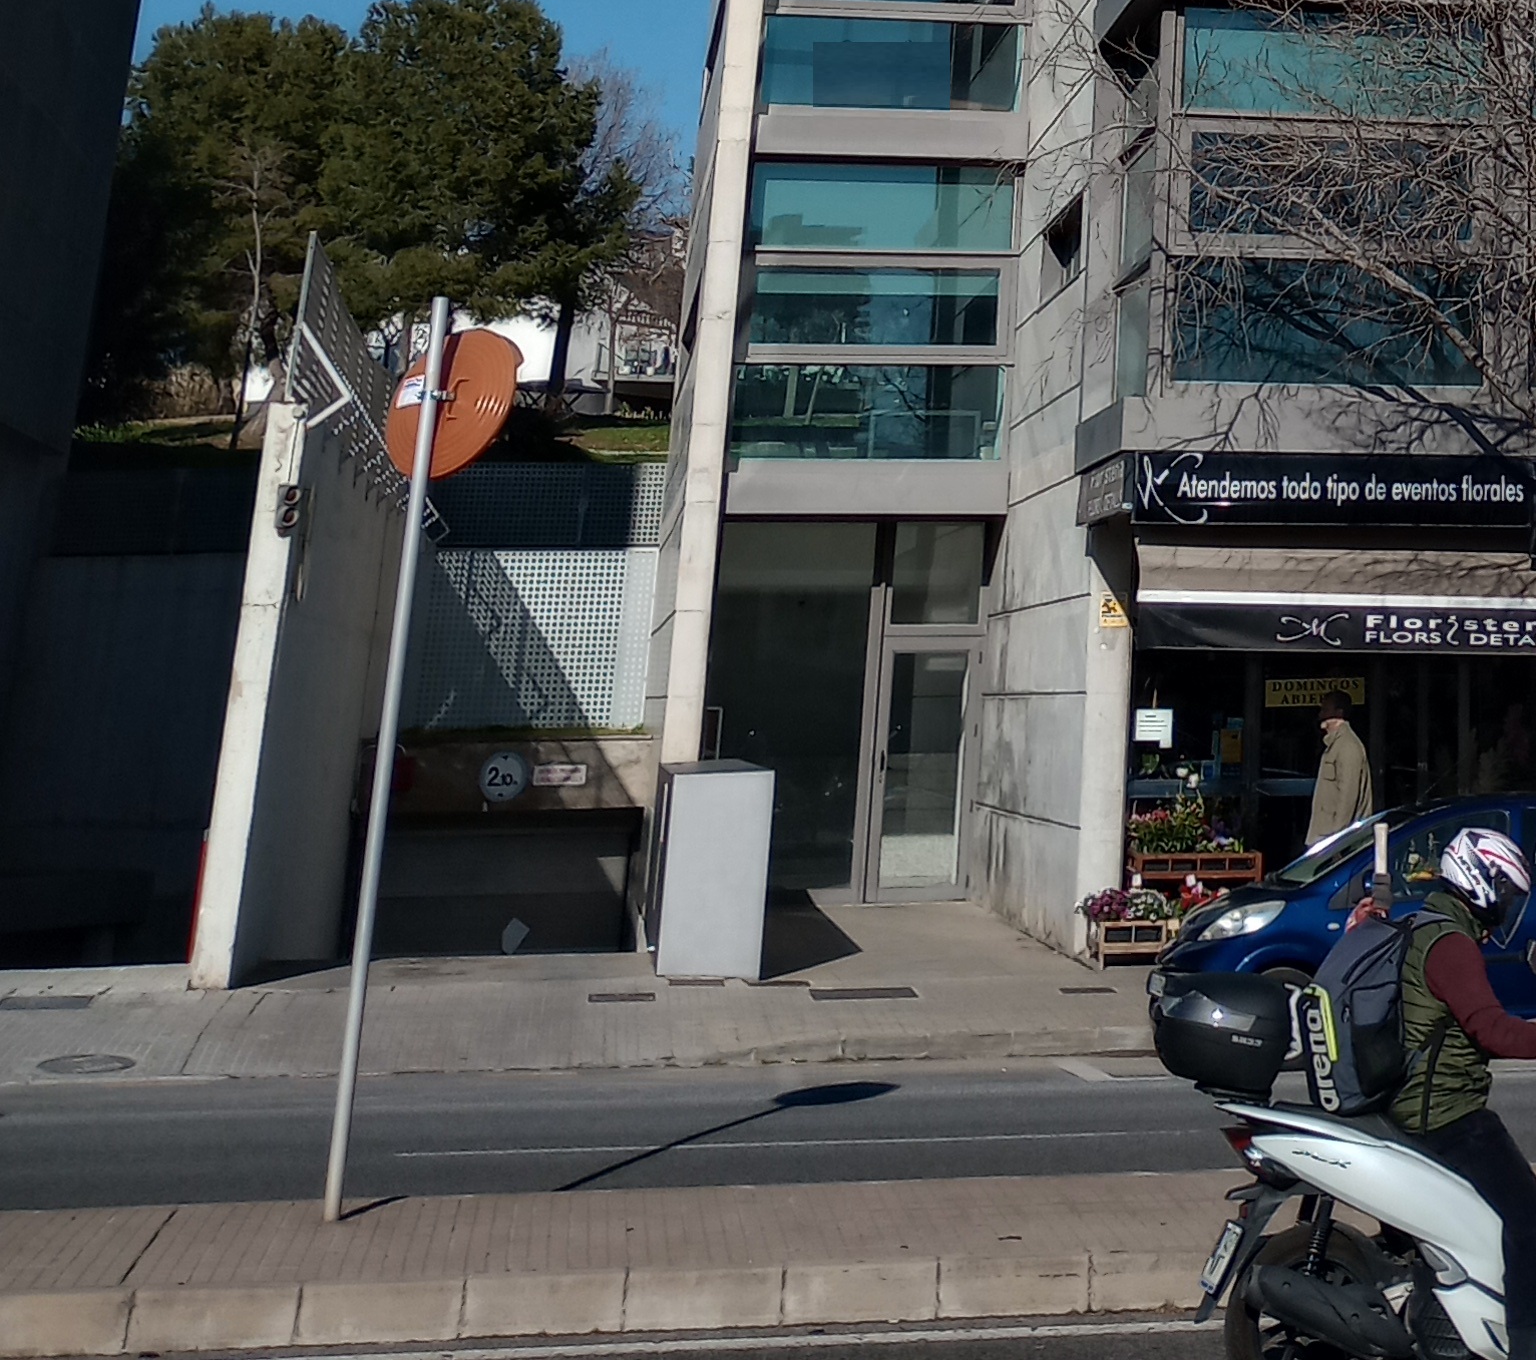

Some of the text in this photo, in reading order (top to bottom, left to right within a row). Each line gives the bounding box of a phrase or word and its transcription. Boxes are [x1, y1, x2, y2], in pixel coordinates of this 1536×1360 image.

[1177, 471, 1524, 506] Atendemos todo tipo de eventos florales
[1365, 630, 1442, 644] FLORS
[1272, 680, 1360, 692] DOMINGOS
[1306, 1009, 1340, 1112] arena
